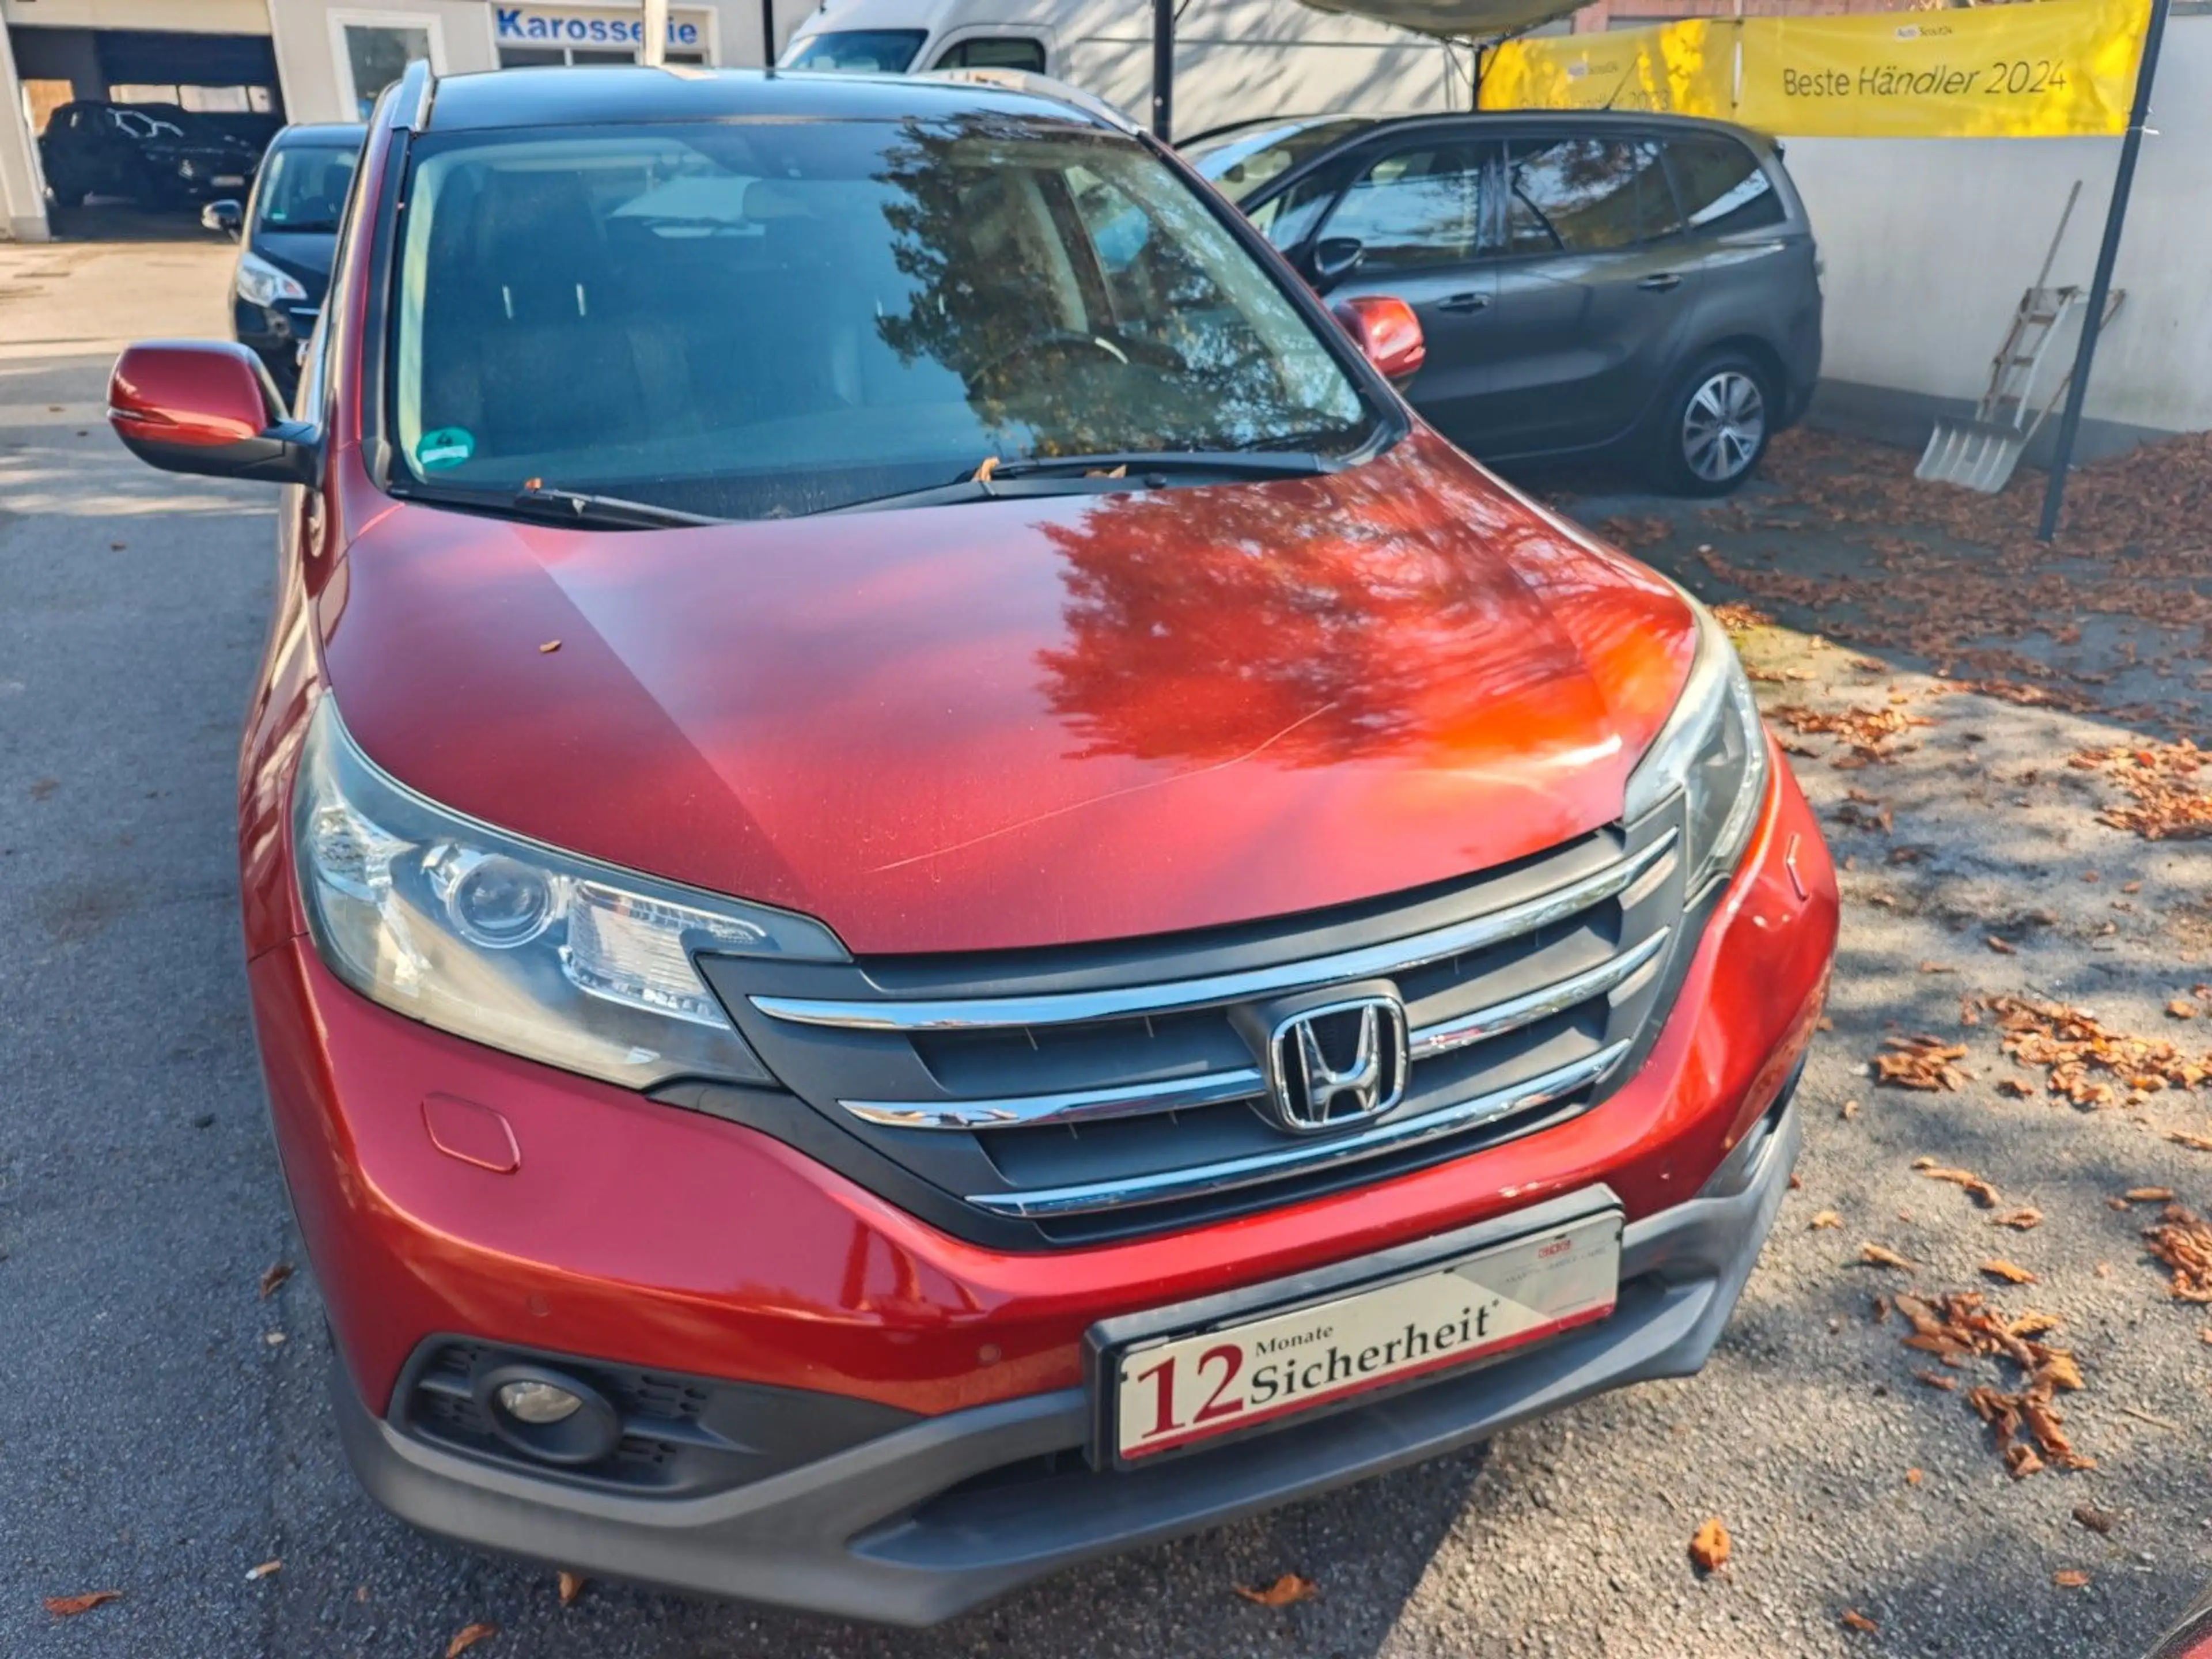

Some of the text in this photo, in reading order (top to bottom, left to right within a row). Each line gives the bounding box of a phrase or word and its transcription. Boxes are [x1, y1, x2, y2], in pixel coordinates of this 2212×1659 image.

[497, 8, 697, 44] Karosseie
[1783, 60, 2066, 97] Beste Händler 2024
[1256, 1325, 1334, 1357] Monate
[1137, 1344, 1244, 1439] 12
